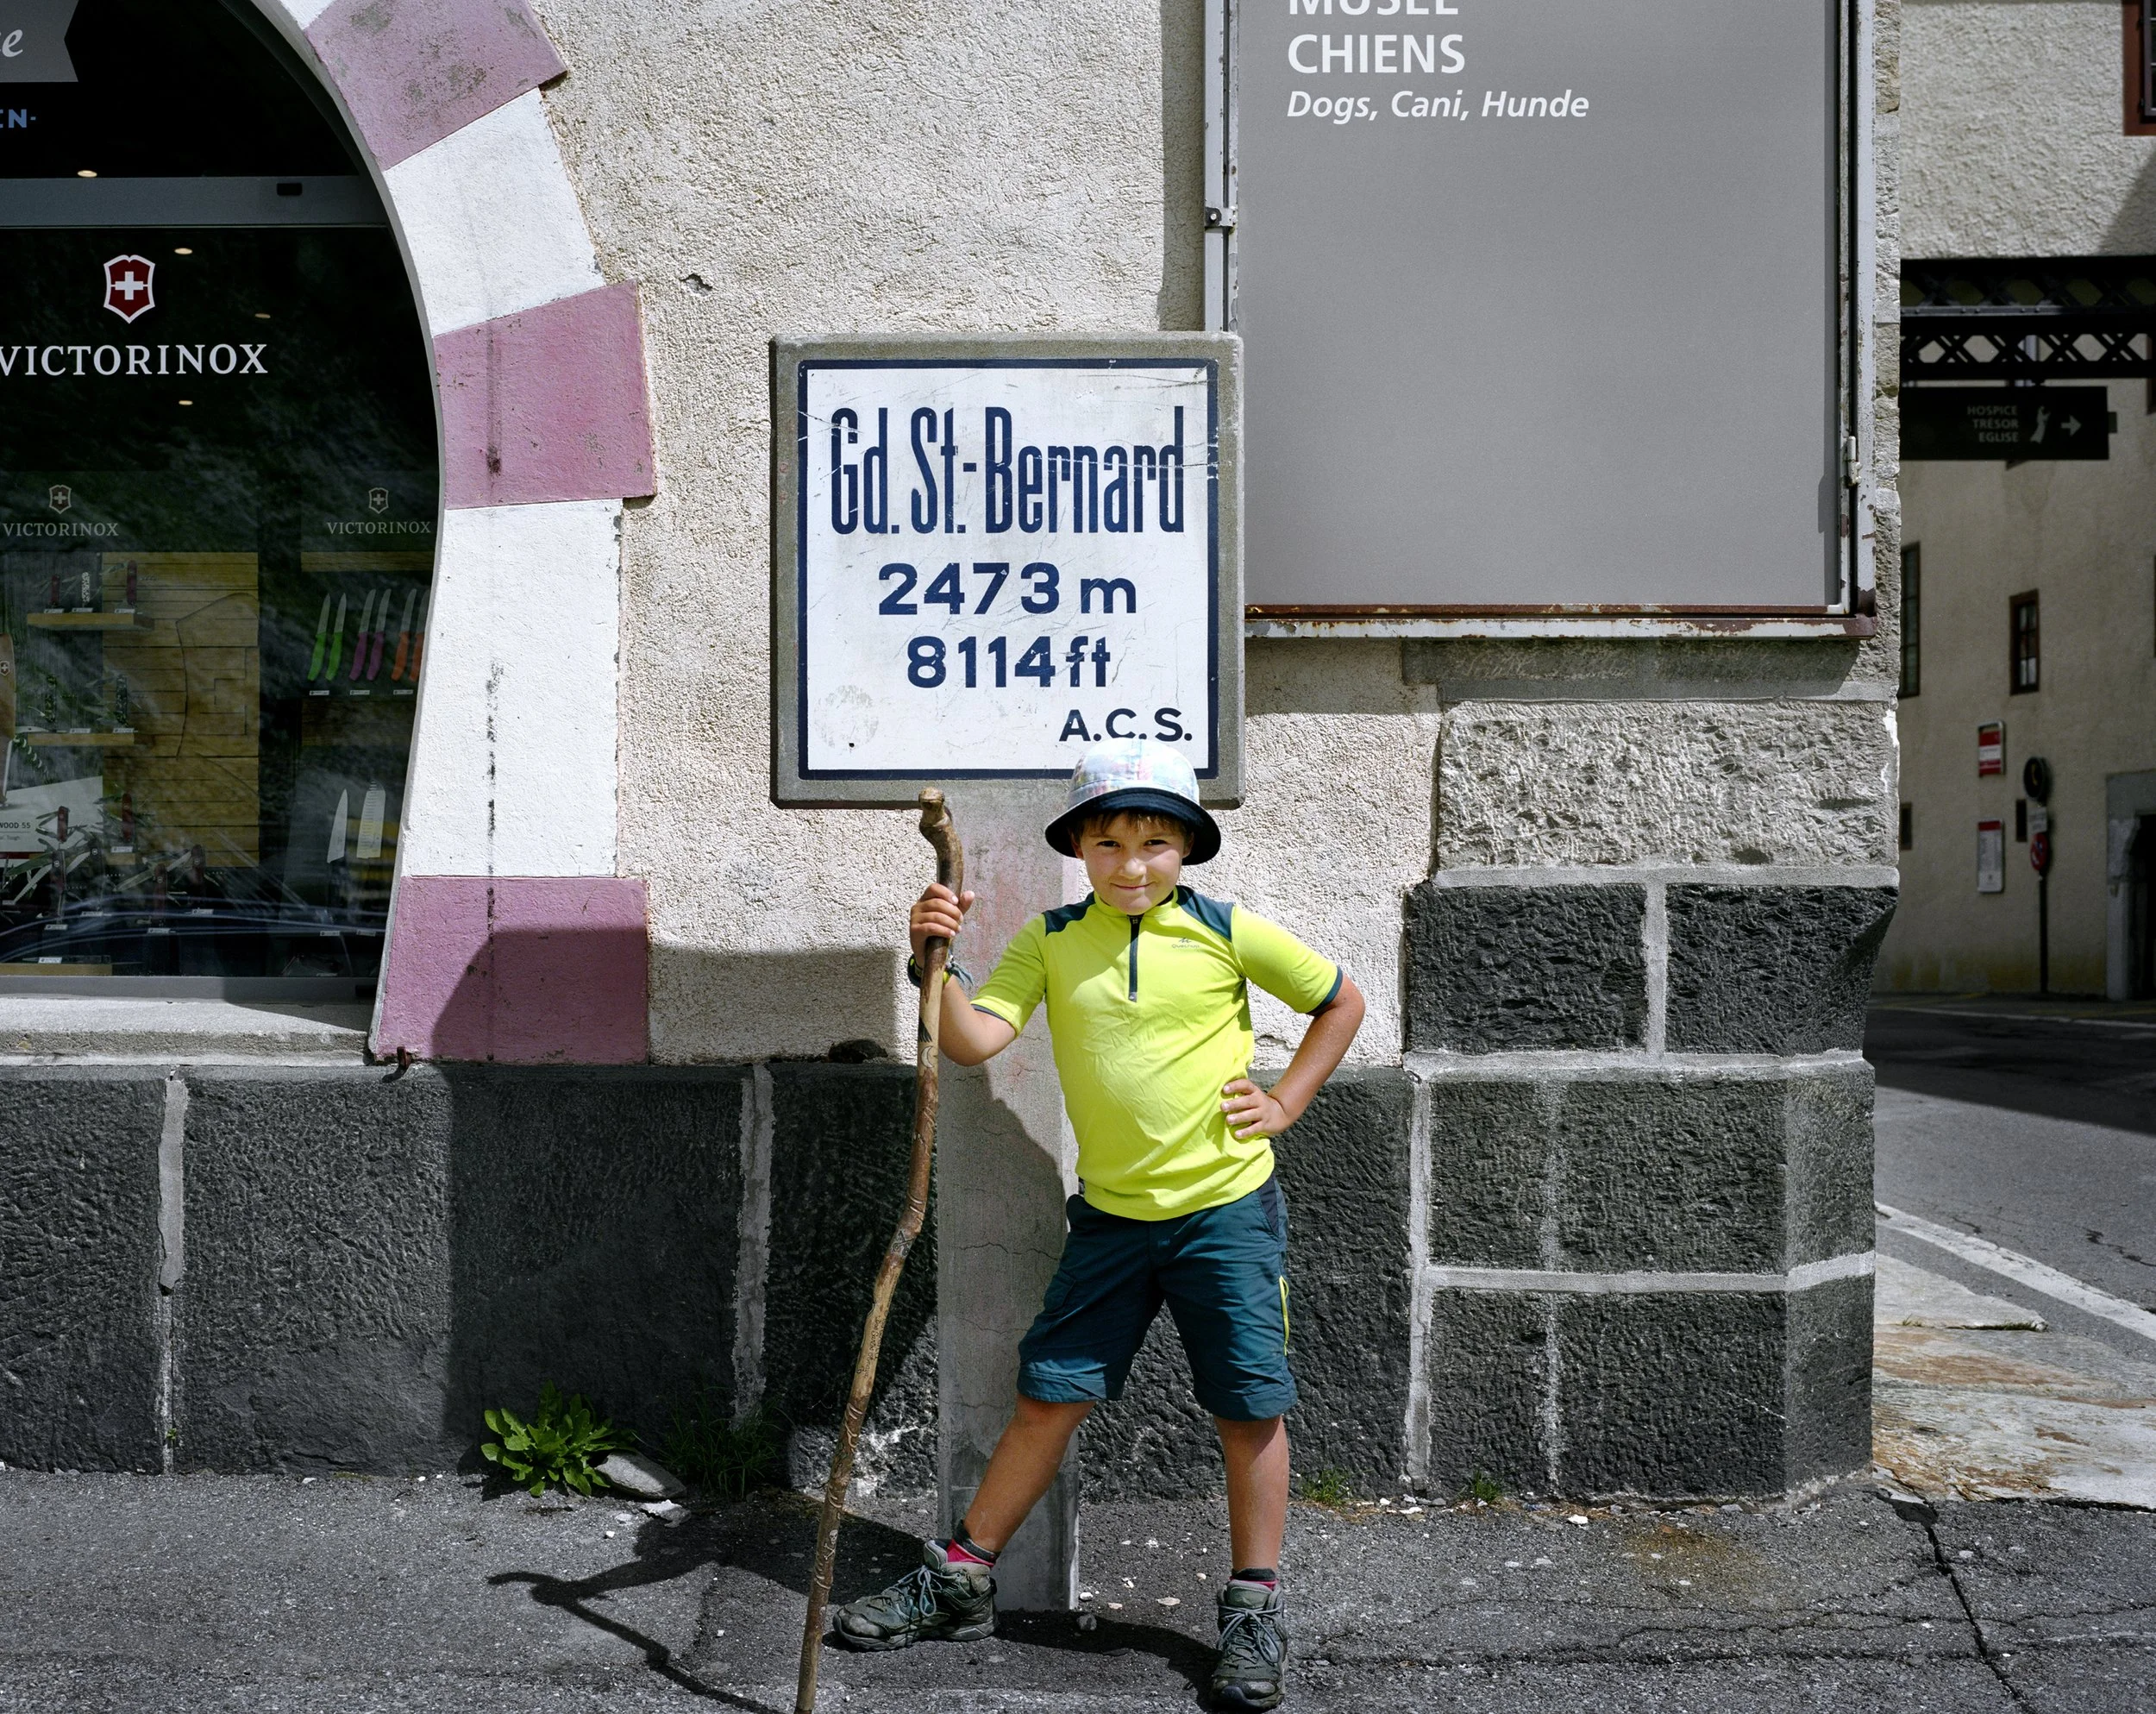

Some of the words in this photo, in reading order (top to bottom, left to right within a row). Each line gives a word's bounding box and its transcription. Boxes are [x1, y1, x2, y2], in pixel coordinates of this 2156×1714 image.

[1288, 34, 1465, 74] CHIENS
[1288, 91, 1380, 125] Dogs,
[1391, 90, 1470, 122] Cani,
[1482, 89, 1590, 117] Hunde
[0, 343, 268, 376] VICTORINOX
[1967, 405, 2018, 416] HOSPICE
[830, 407, 900, 535] Gd.
[3, 522, 119, 537] VICTORINOX
[327, 521, 431, 535] VICTORINOX
[878, 562, 1061, 616] 2473
[1080, 577, 1138, 615] m
[906, 636, 1056, 689] 8114
[1065, 636, 1112, 688] ft
[1058, 707, 1194, 743] A.C.S.
